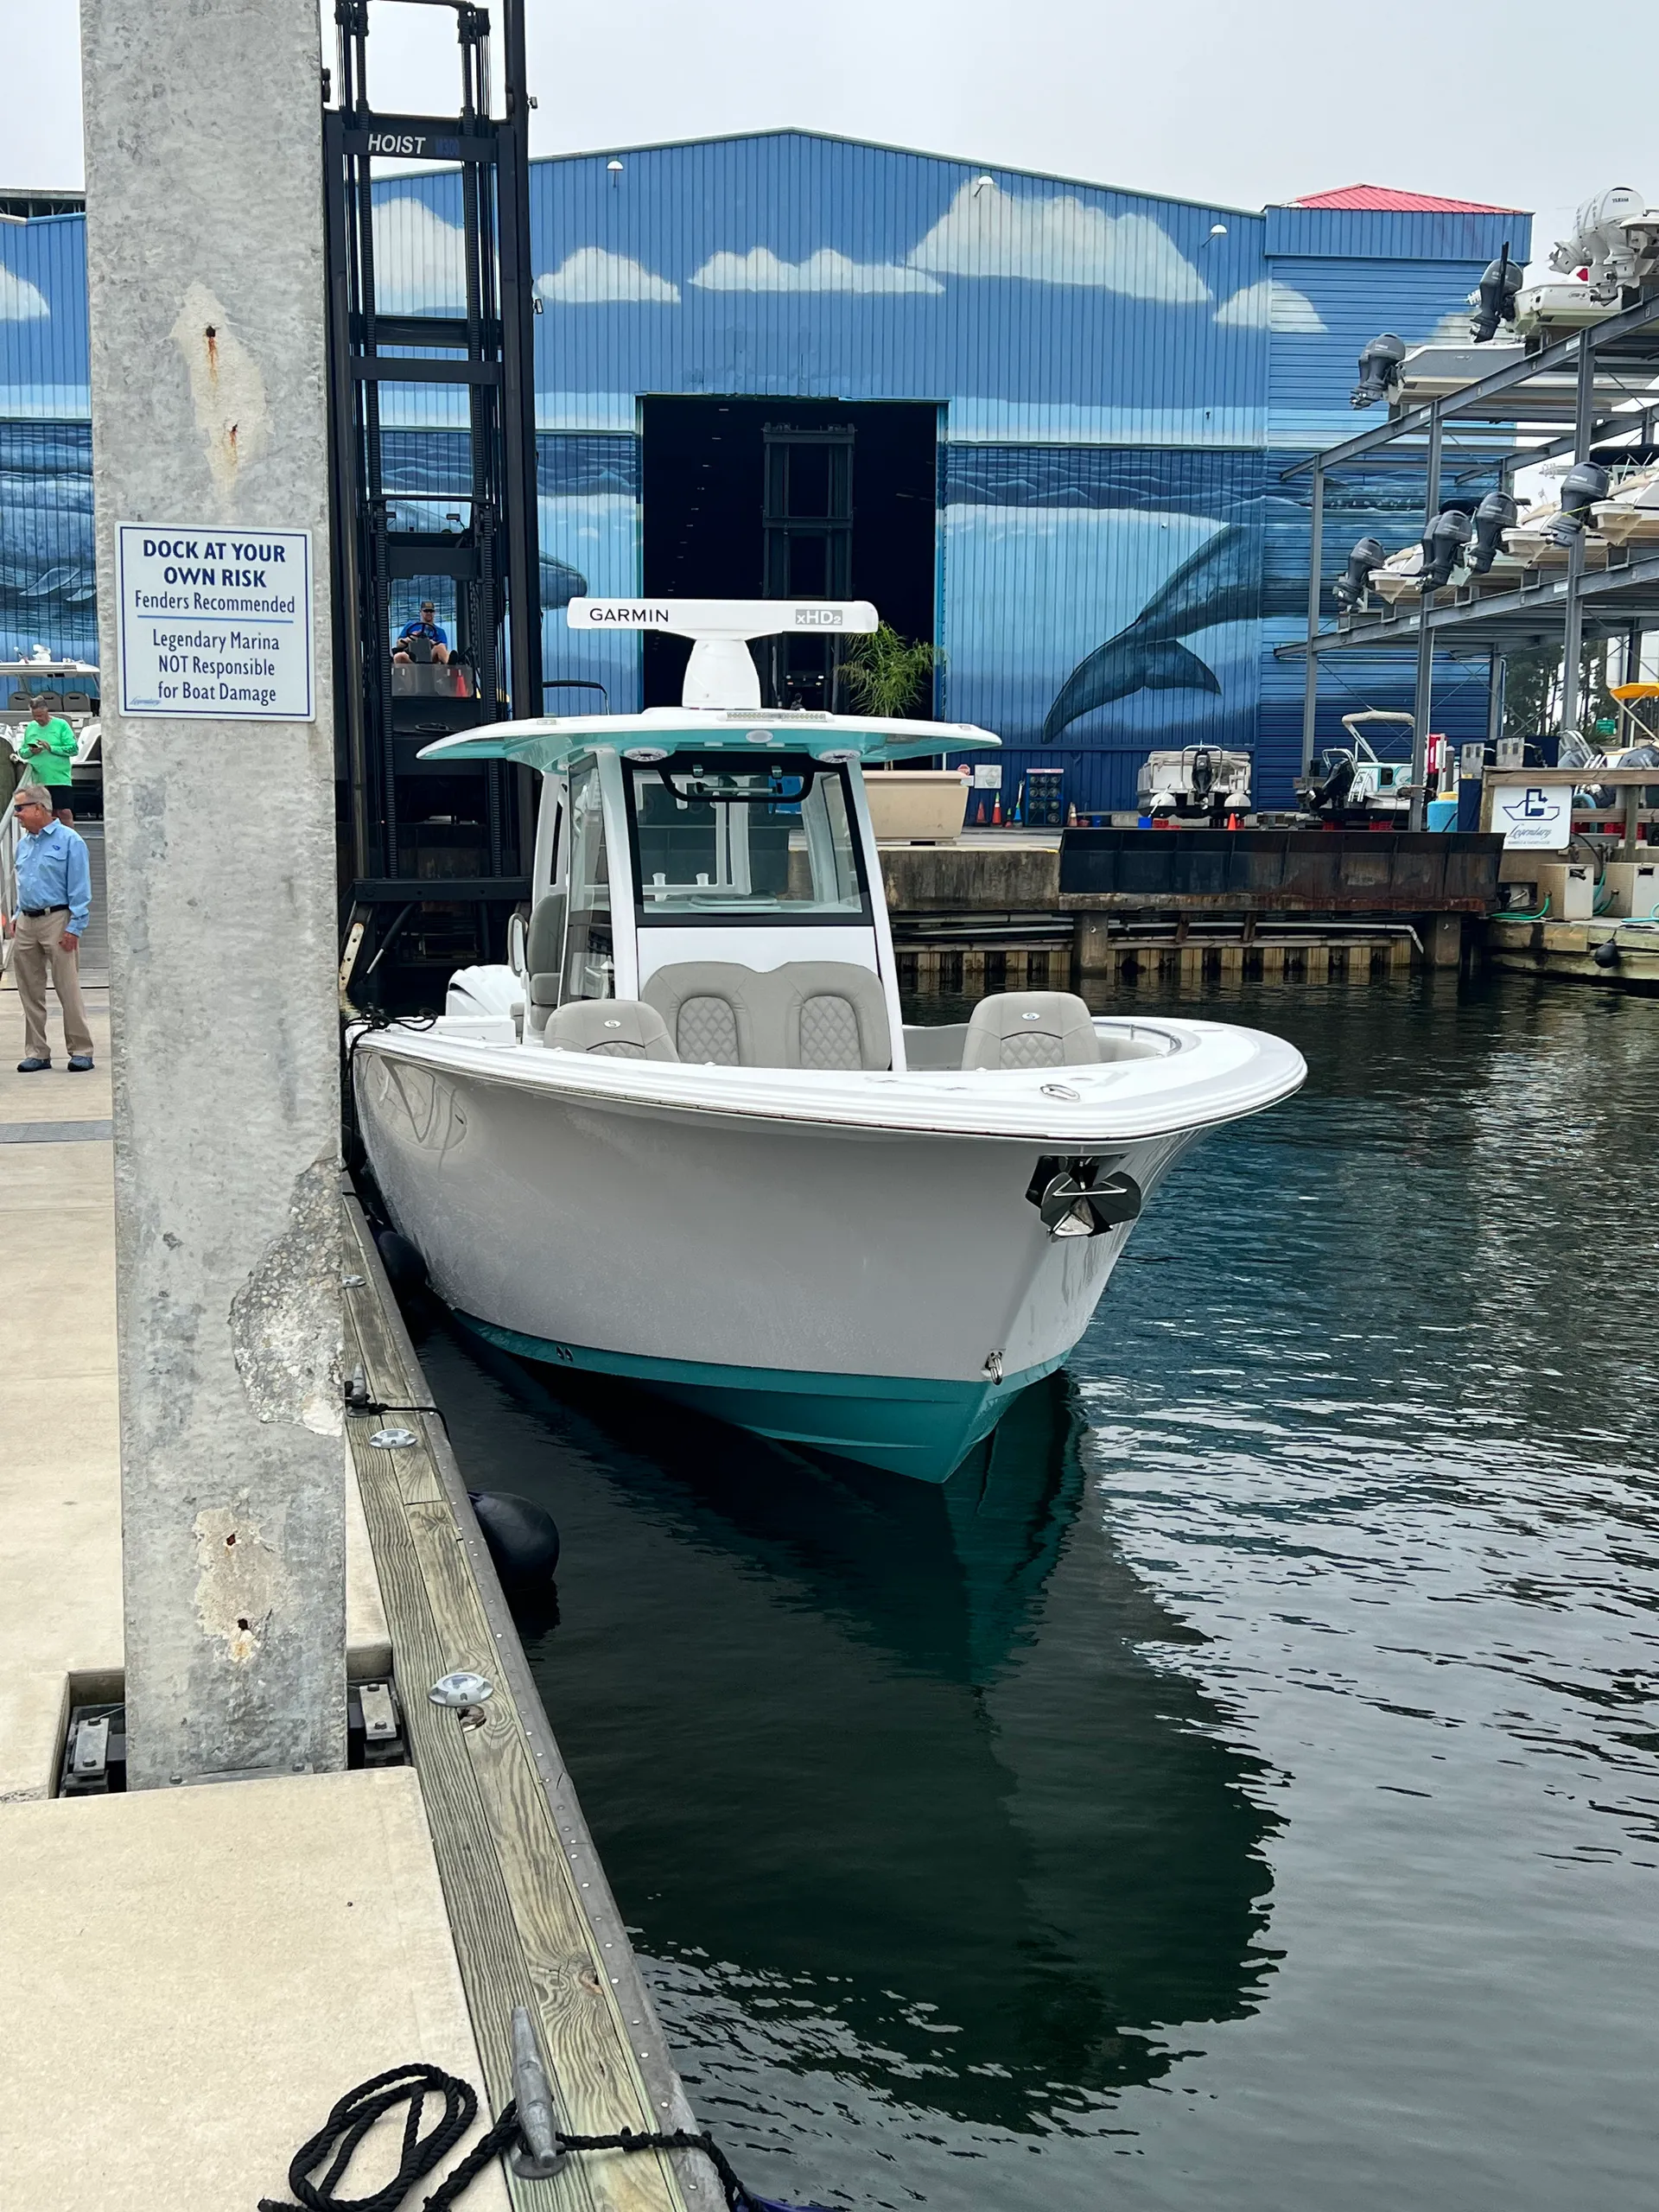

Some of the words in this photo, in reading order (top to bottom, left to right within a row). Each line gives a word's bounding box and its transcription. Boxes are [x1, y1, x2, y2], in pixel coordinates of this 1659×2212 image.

[368, 134, 426, 154] HOIST
[143, 539, 199, 559] DOCK
[204, 543, 226, 560] AT
[231, 543, 286, 563] YOUR
[163, 567, 215, 586] OWN
[222, 569, 267, 588] RISK
[136, 590, 189, 609] Fenders
[194, 592, 295, 613] Recommended
[589, 608, 669, 622] GARMIN
[153, 629, 226, 653] Legendary
[231, 632, 279, 650] Marina
[159, 655, 188, 672] NOT
[193, 656, 275, 679] Responsible
[158, 681, 178, 698] for
[182, 682, 215, 700] Boat
[219, 683, 276, 707] Damage
[1506, 823, 1553, 840] Legendary
